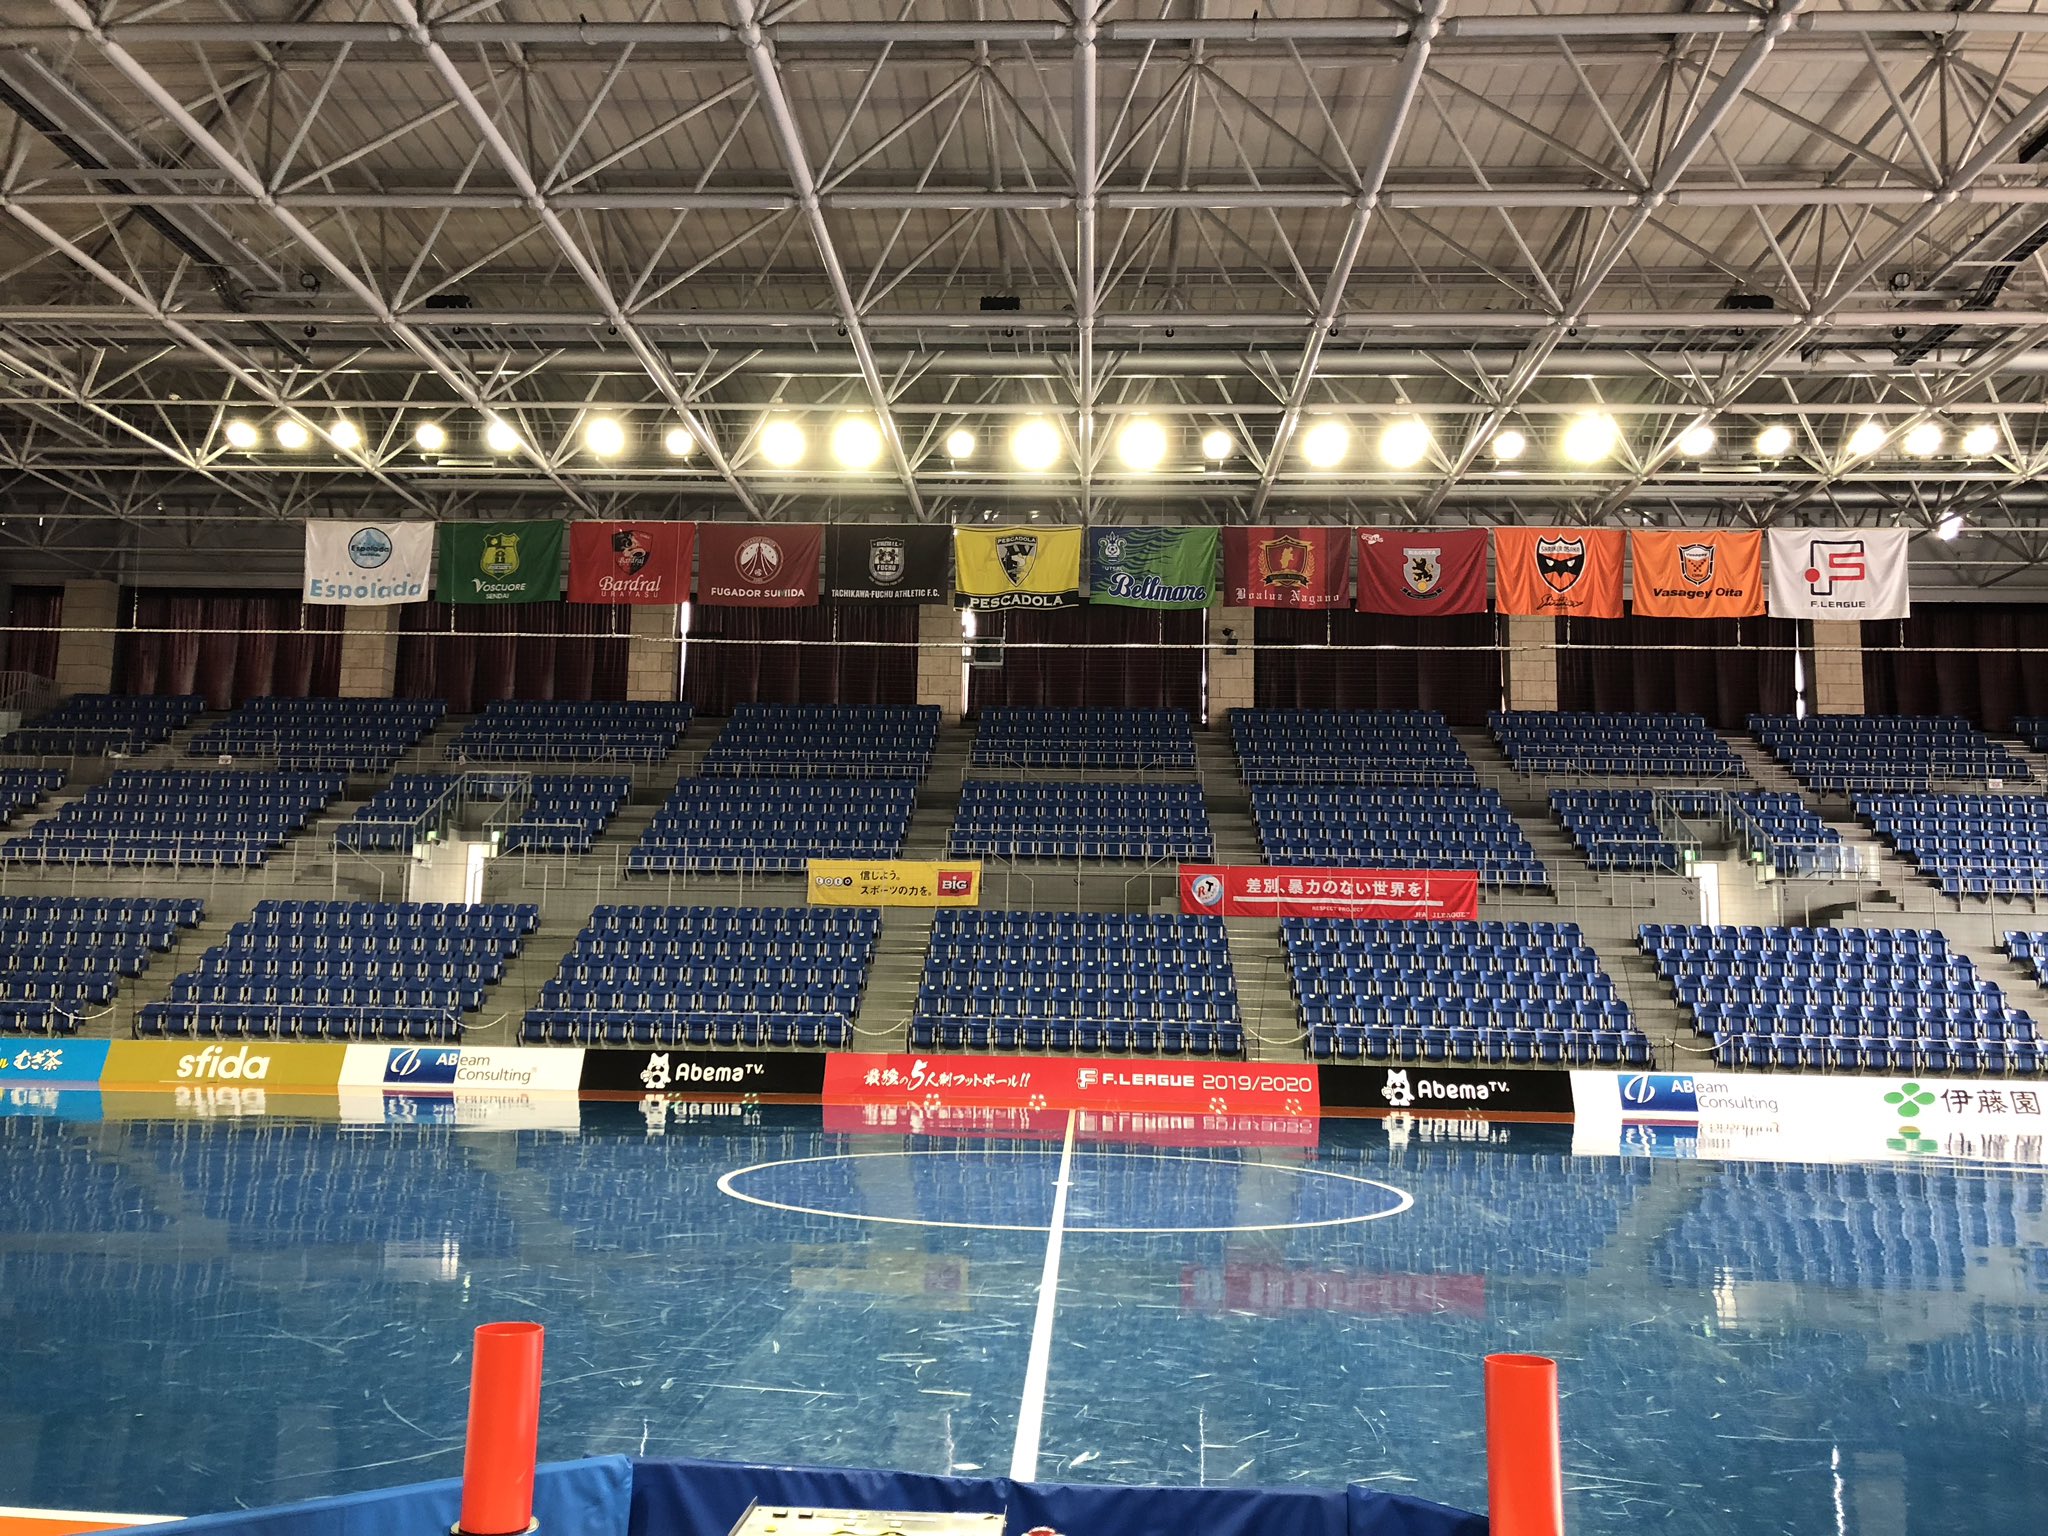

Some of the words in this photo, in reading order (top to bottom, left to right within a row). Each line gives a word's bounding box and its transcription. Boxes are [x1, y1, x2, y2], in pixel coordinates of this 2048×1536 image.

[310, 579, 421, 599] Espolada
[472, 578, 527, 592] VOSCUORE
[599, 574, 661, 592] Bardral
[1107, 572, 1207, 602] Bellmare
[711, 587, 761, 597] FUGADOR
[764, 588, 805, 597] SUMIDA
[894, 589, 926, 598] ATHLETIC
[927, 588, 940, 597] F.C.
[1290, 590, 1340, 606] Nagano
[1653, 588, 1712, 600] Vasagey
[1715, 587, 1743, 597] Oita
[969, 594, 1063, 609] PESCADOLA
[1810, 600, 1866, 608] F.LEAGUE
[13, 1048, 63, 1071] むぎ茶
[176, 1045, 271, 1079] sfida
[435, 1053, 490, 1066] ABeam
[457, 1068, 531, 1085] Consulting
[1102, 1073, 1195, 1087] F.LEAGUE
[1202, 1074, 1313, 1092] 2019/2020
[1671, 1079, 1729, 1093] ABeam
[1698, 1095, 1779, 1113] Consulting
[1940, 1088, 2041, 1115] 伊藤園
